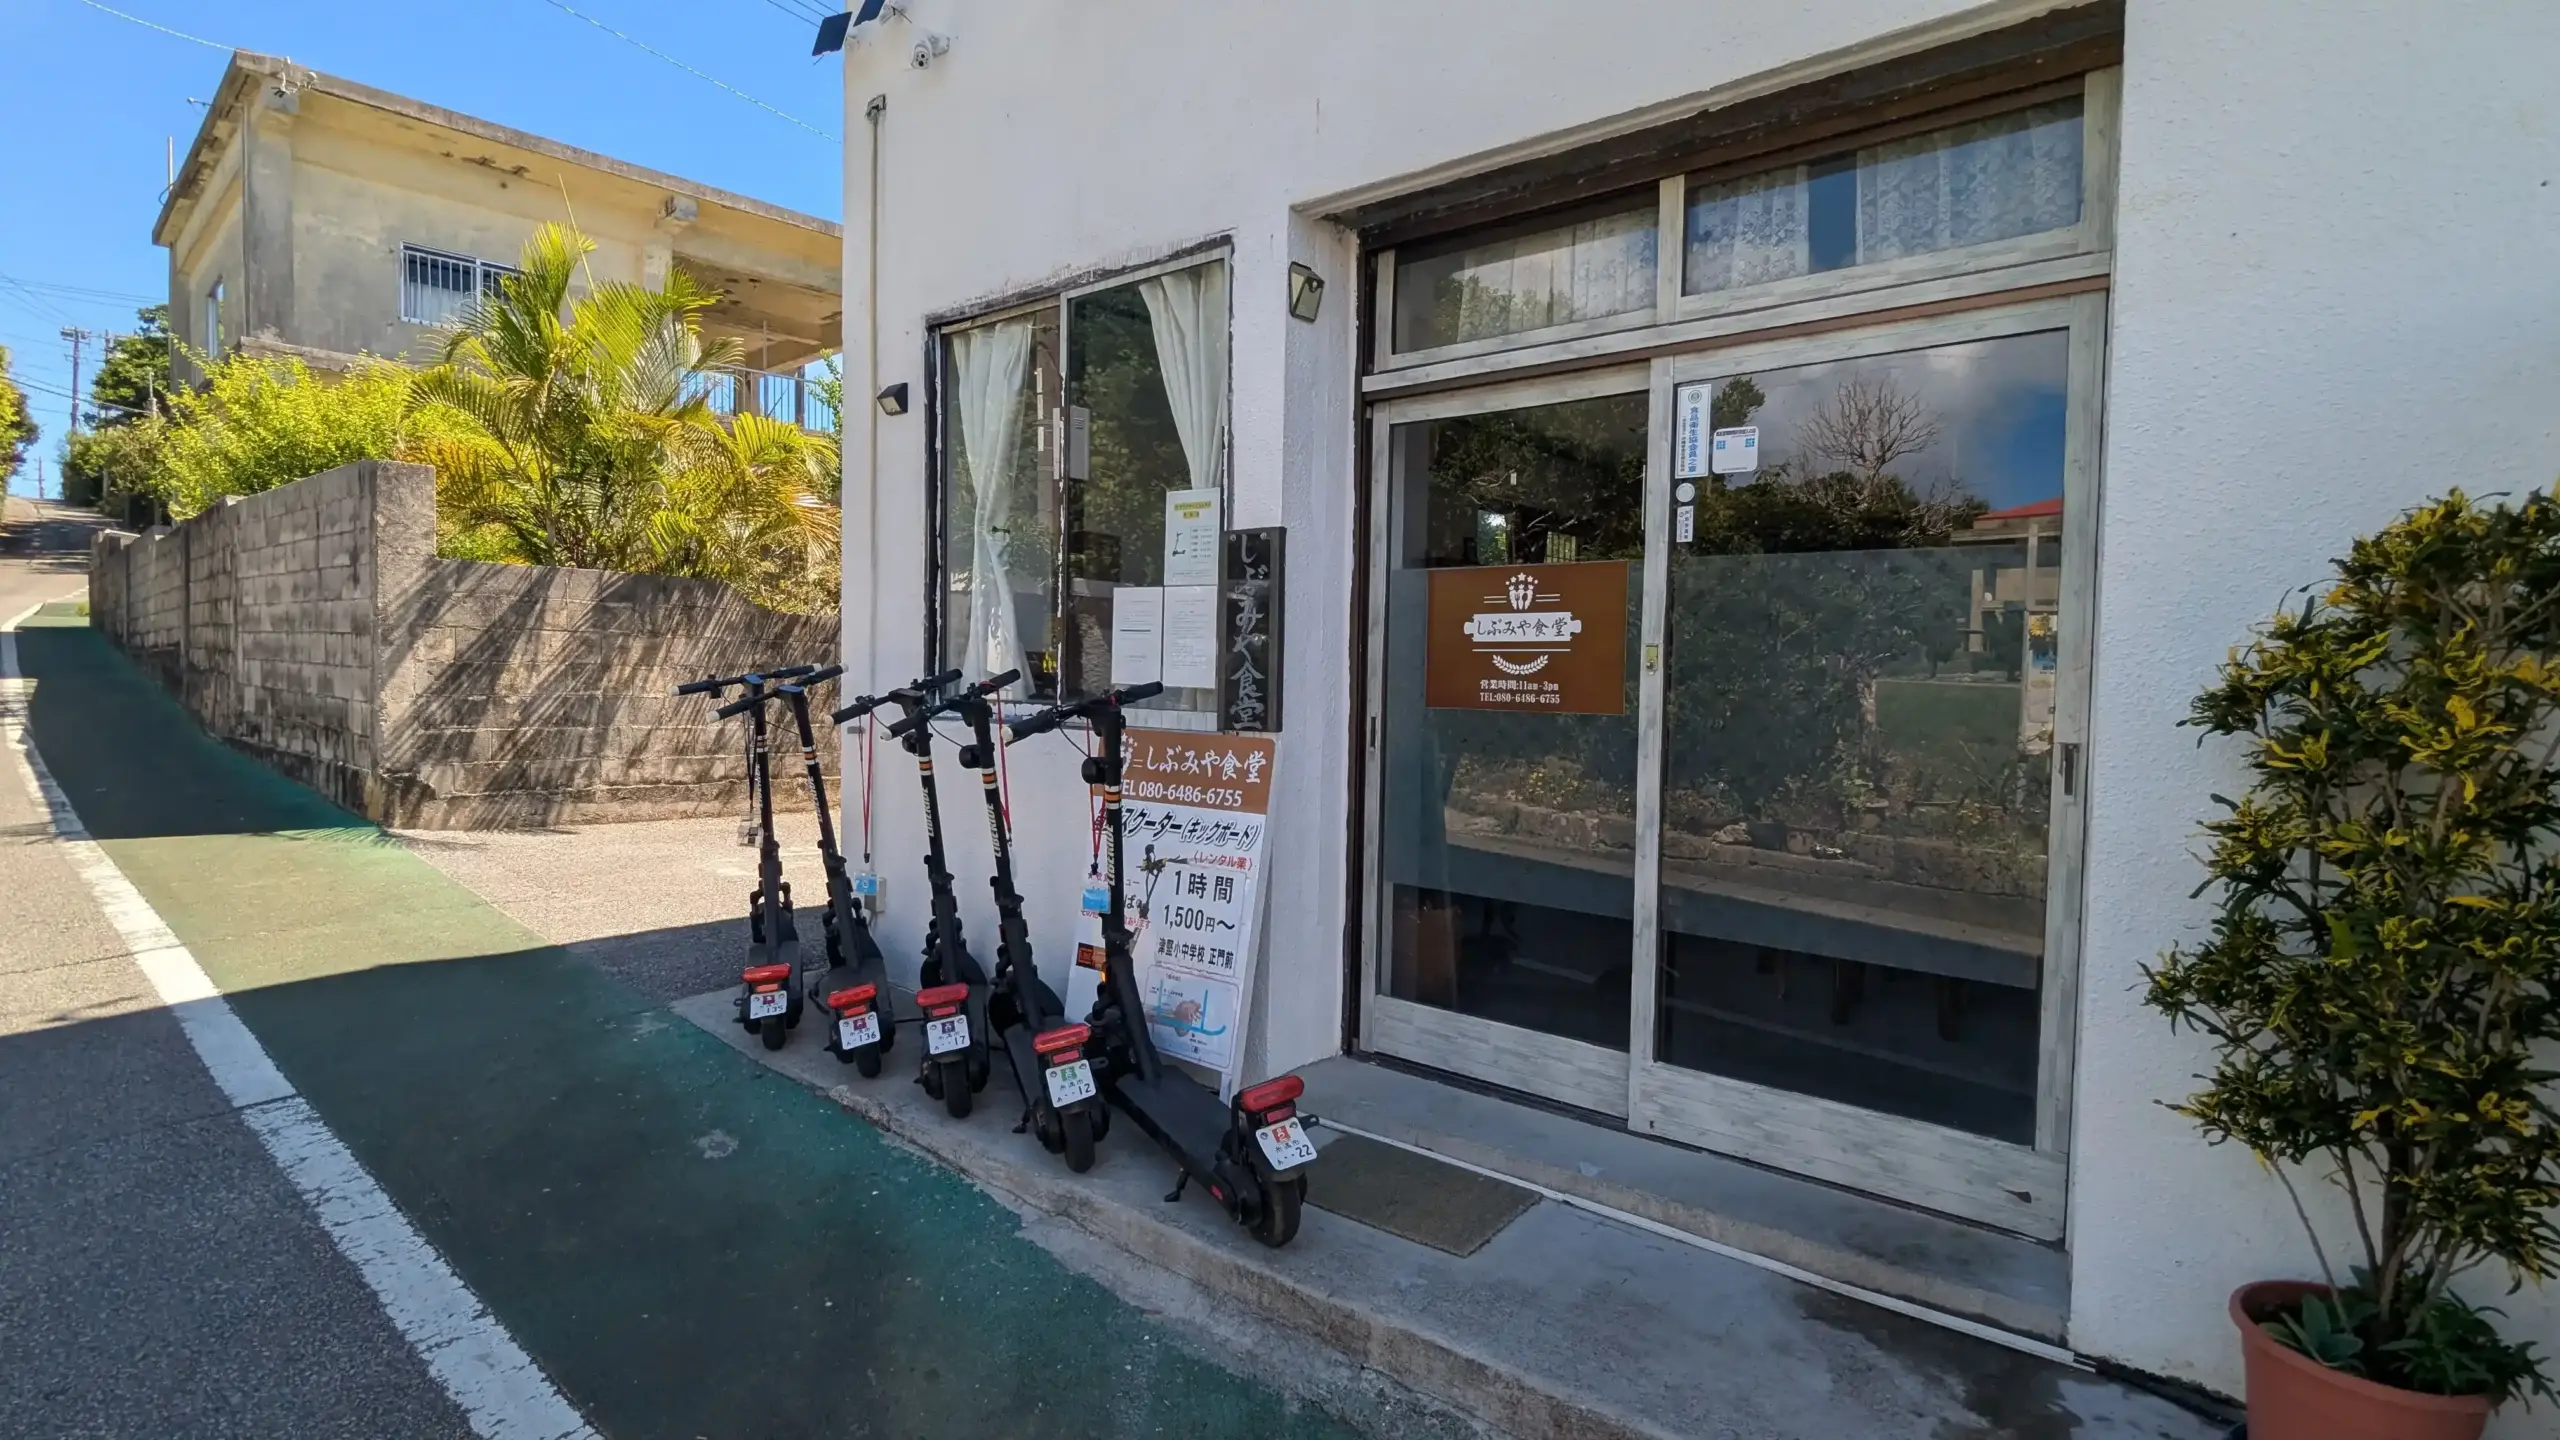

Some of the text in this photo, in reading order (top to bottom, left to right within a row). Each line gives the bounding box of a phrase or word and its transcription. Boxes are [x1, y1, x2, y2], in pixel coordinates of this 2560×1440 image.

[1230, 534, 1269, 730] しぶみや食堂
[1477, 617, 1568, 637] しぶみや食堂
[1147, 745, 1267, 784] しぶみや食堂
[1139, 781, 1243, 807] 080-6486-6755
[1121, 804, 1262, 851] スクーター(キックボード)
[1175, 869, 1234, 904] 1時間
